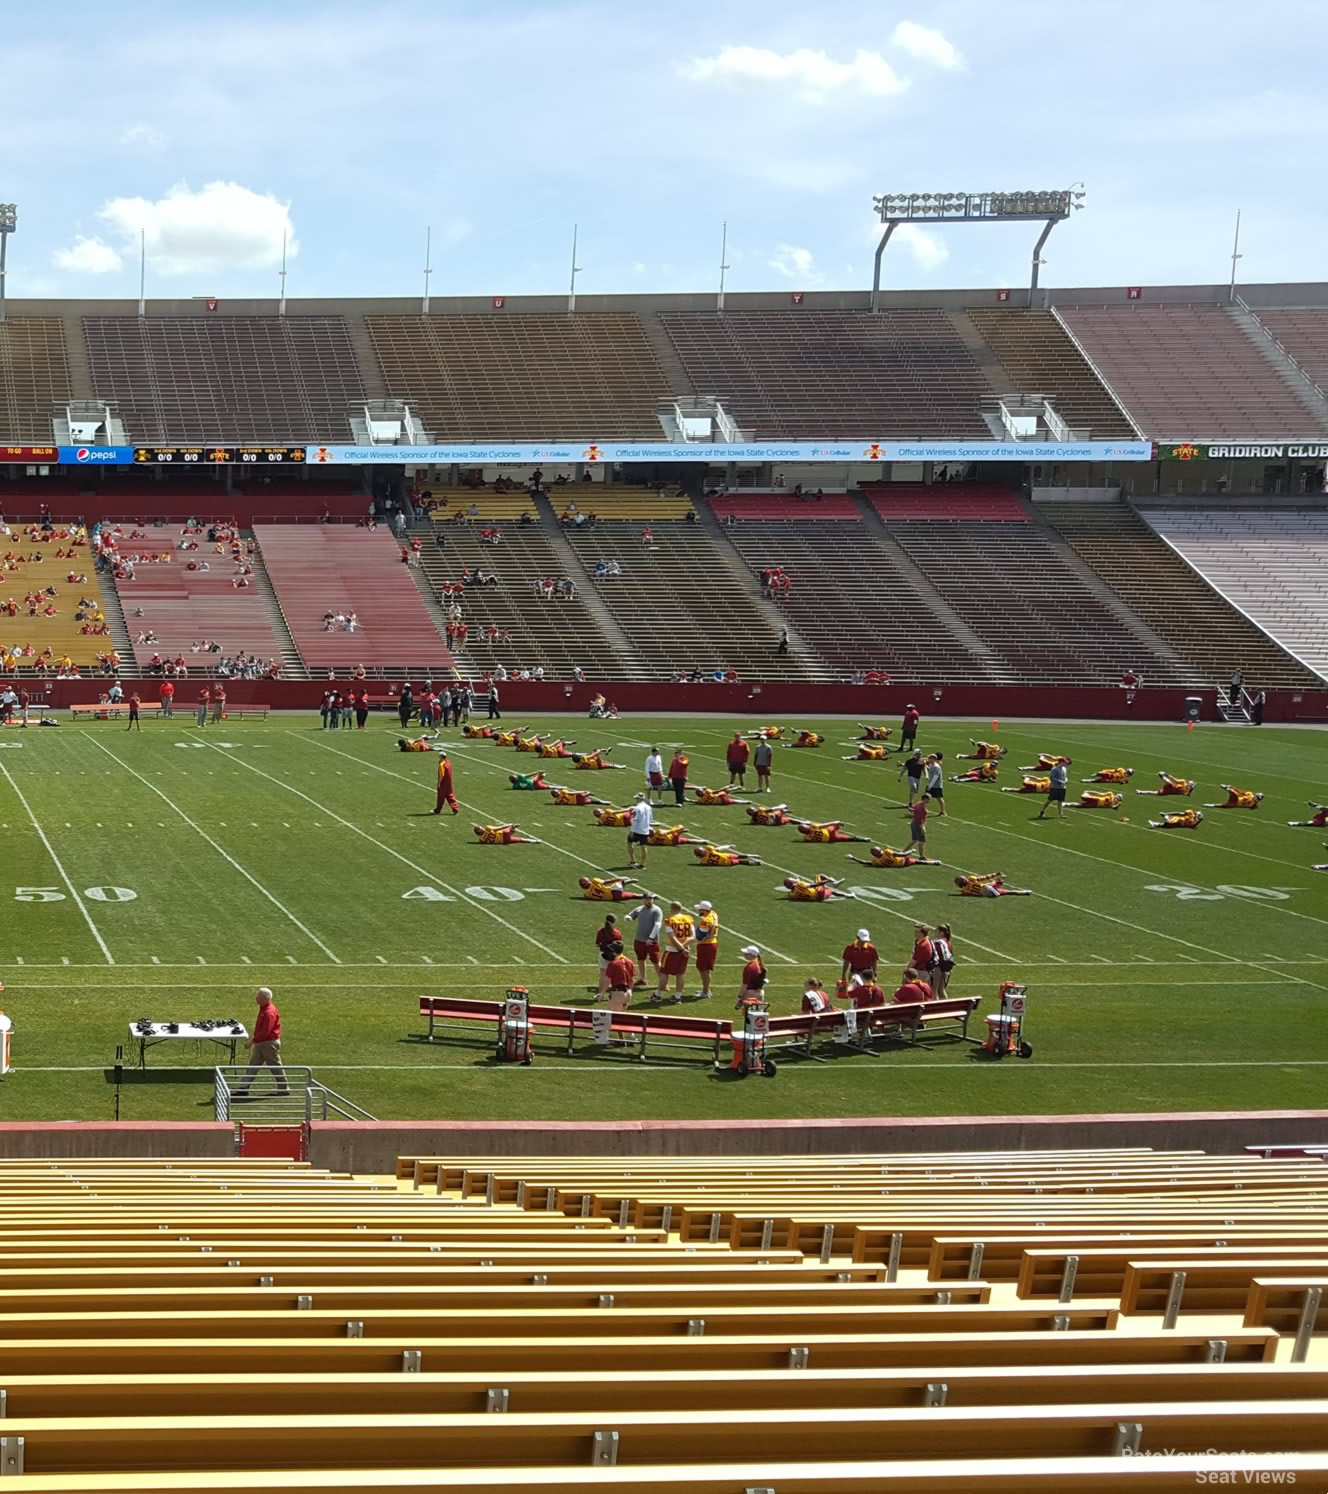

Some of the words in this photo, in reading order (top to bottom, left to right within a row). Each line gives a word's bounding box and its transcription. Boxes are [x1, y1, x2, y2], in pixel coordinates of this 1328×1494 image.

[90, 451, 116, 461] pepsi
[344, 450, 368, 459] Official
[370, 450, 398, 458] Wireless
[399, 450, 428, 460] Sponsor
[452, 450, 468, 458] Iowa
[470, 450, 487, 458] State
[488, 450, 520, 460] Cyclones
[616, 449, 640, 458] Official
[640, 449, 671, 457] Wireless
[673, 450, 702, 459] Sponsor
[766, 449, 800, 458] Cyclones
[898, 448, 924, 456] Official
[926, 448, 958, 456] Wireless
[958, 448, 990, 458] Sponsor
[992, 448, 1000, 456] of
[1000, 448, 1013, 456] the
[1016, 448, 1034, 456] Iowa
[1035, 448, 1054, 456] State
[1056, 448, 1092, 458] Cyclones
[1208, 446, 1284, 458] GRIDIRON
[1288, 446, 1328, 458] CLUB
[158, 453, 172, 462] 0/0
[184, 453, 198, 462] 0/0
[242, 454, 256, 462] 0/0
[268, 454, 282, 462] 0/0
[14, 886, 137, 902] 50
[401, 886, 525, 902] 40
[1144, 885, 1290, 900] 20
